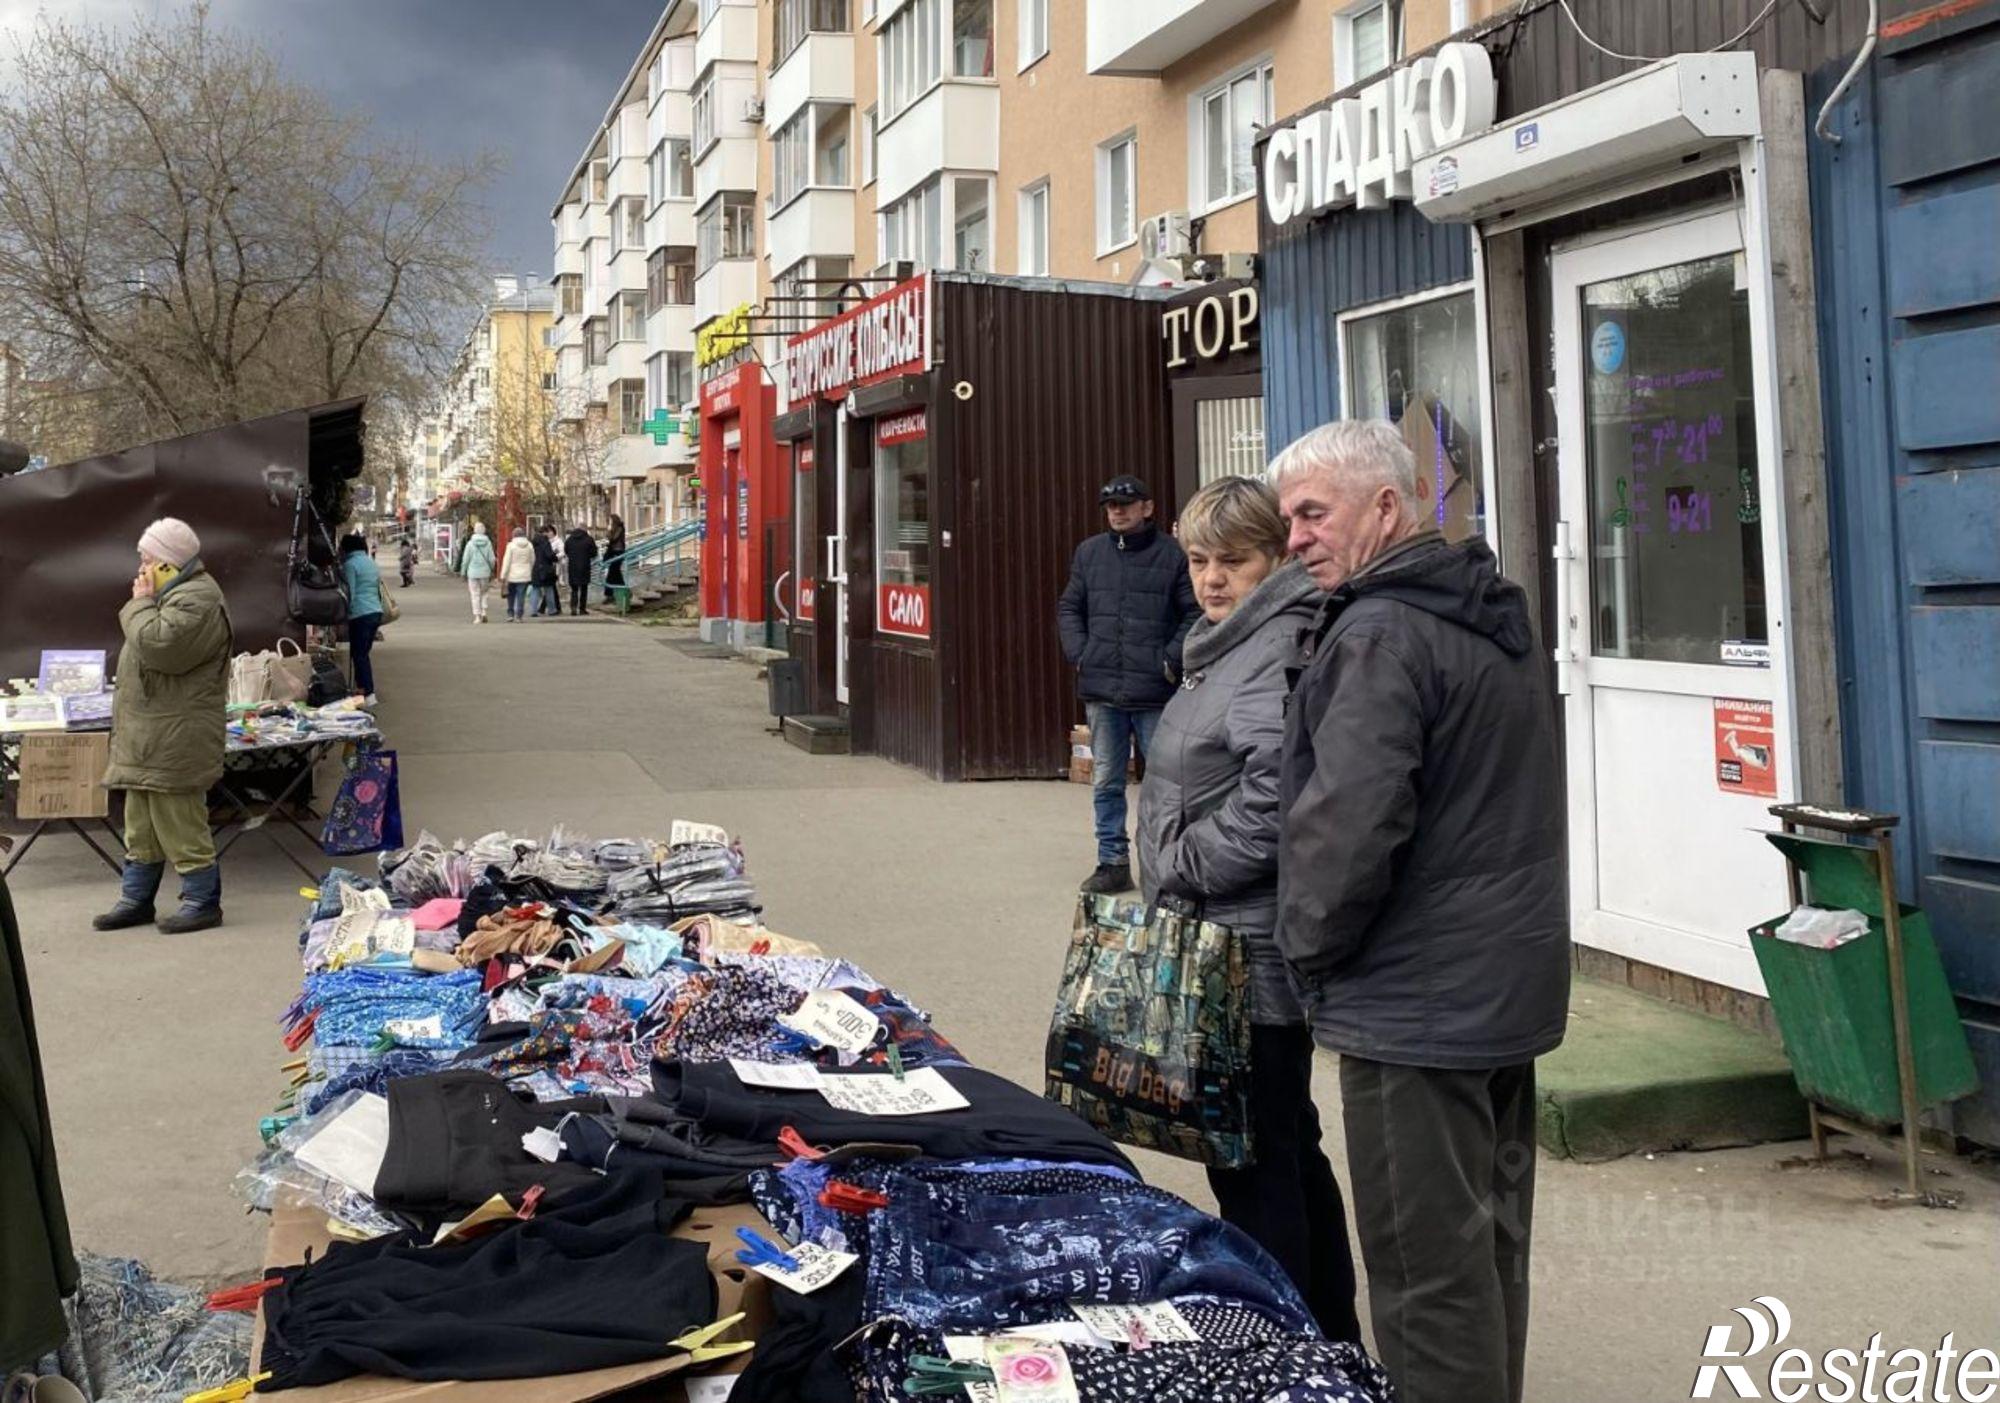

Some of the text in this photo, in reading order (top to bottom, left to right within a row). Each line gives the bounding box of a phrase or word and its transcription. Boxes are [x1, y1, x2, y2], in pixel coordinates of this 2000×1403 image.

[1265, 42, 1482, 225] СЛАДКО
[856, 286, 921, 382] КОЛБАСЫ
[1162, 286, 1259, 368] ТОР
[888, 590, 924, 627] САЛО
[1724, 647, 1769, 658] АЛЬФ
[1715, 699, 1771, 714] ВНИМАНИЕ
[1092, 1046, 1186, 1115] Big bag
